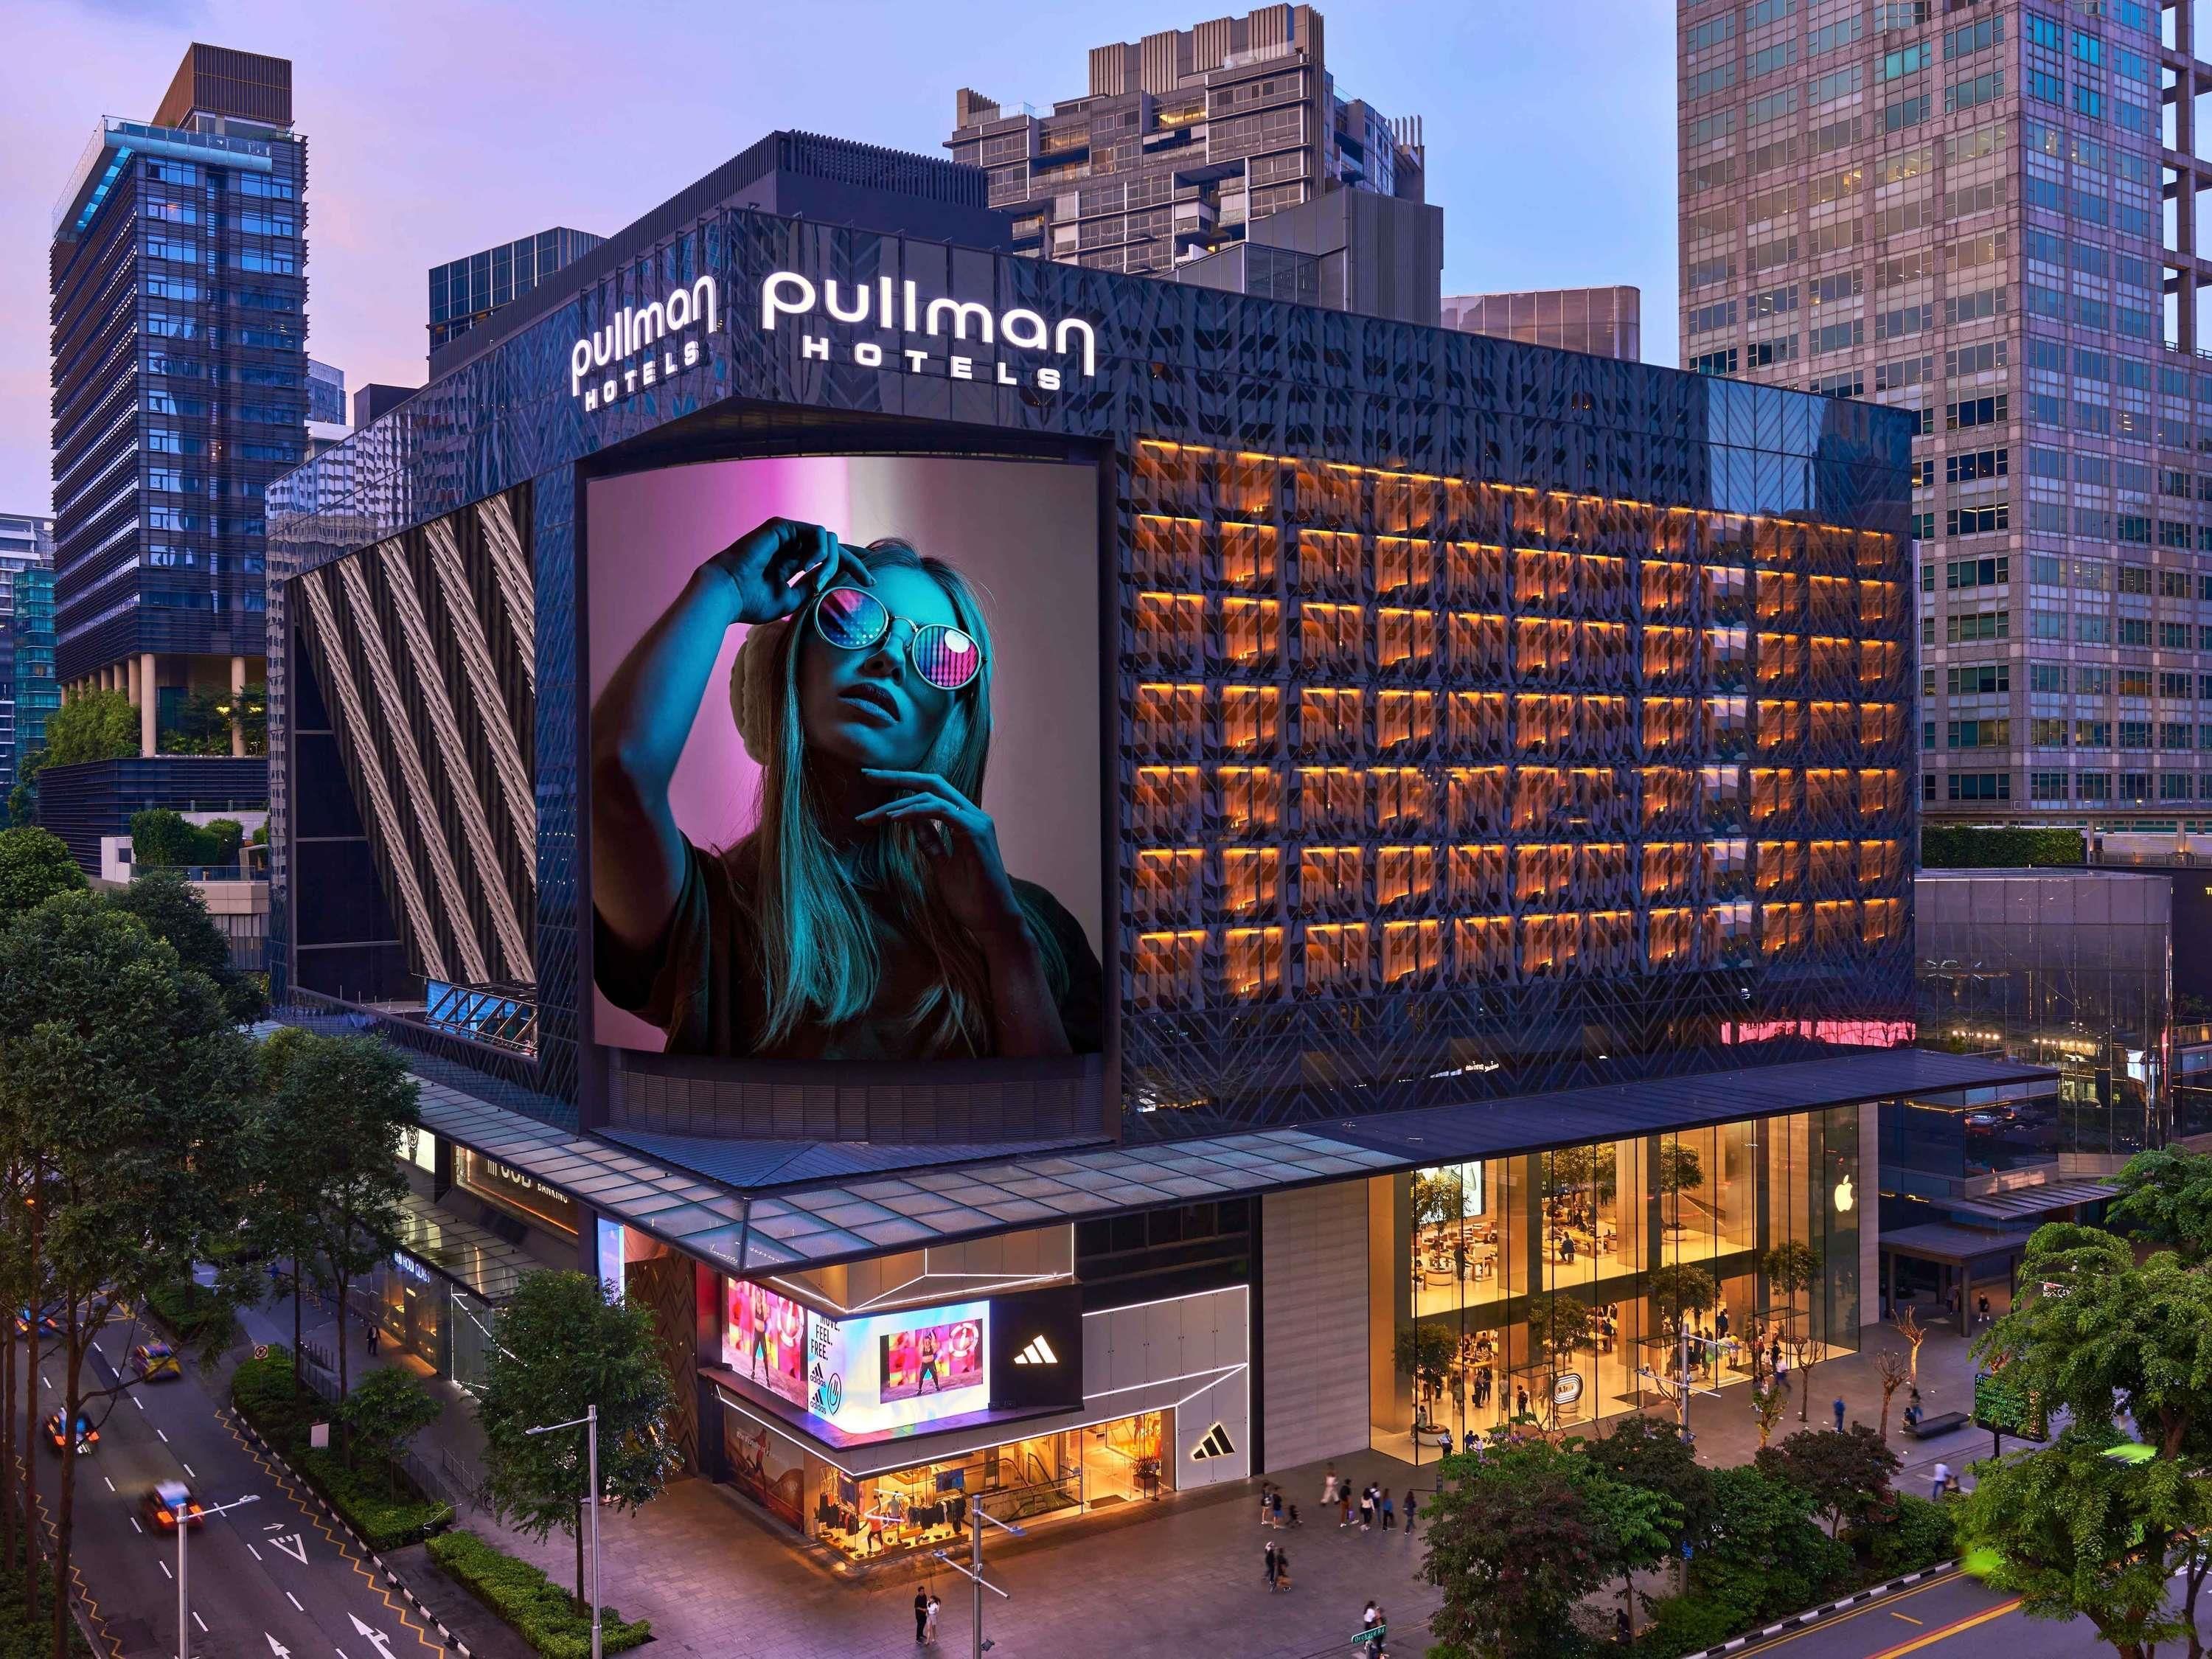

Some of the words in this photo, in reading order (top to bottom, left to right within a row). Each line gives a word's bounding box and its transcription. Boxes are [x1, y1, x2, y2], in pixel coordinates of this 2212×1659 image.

[762, 271, 1096, 378] pullman
[571, 275, 718, 398] pullman
[802, 335, 1061, 392] HOTELS
[585, 341, 700, 412] HOTELS
[815, 1324, 832, 1346] FEEL.
[810, 1338, 828, 1361] FREE.
[810, 1374, 826, 1388] adidas
[810, 1401, 827, 1415] adidas
[1354, 1631, 1377, 1642] Orchard
